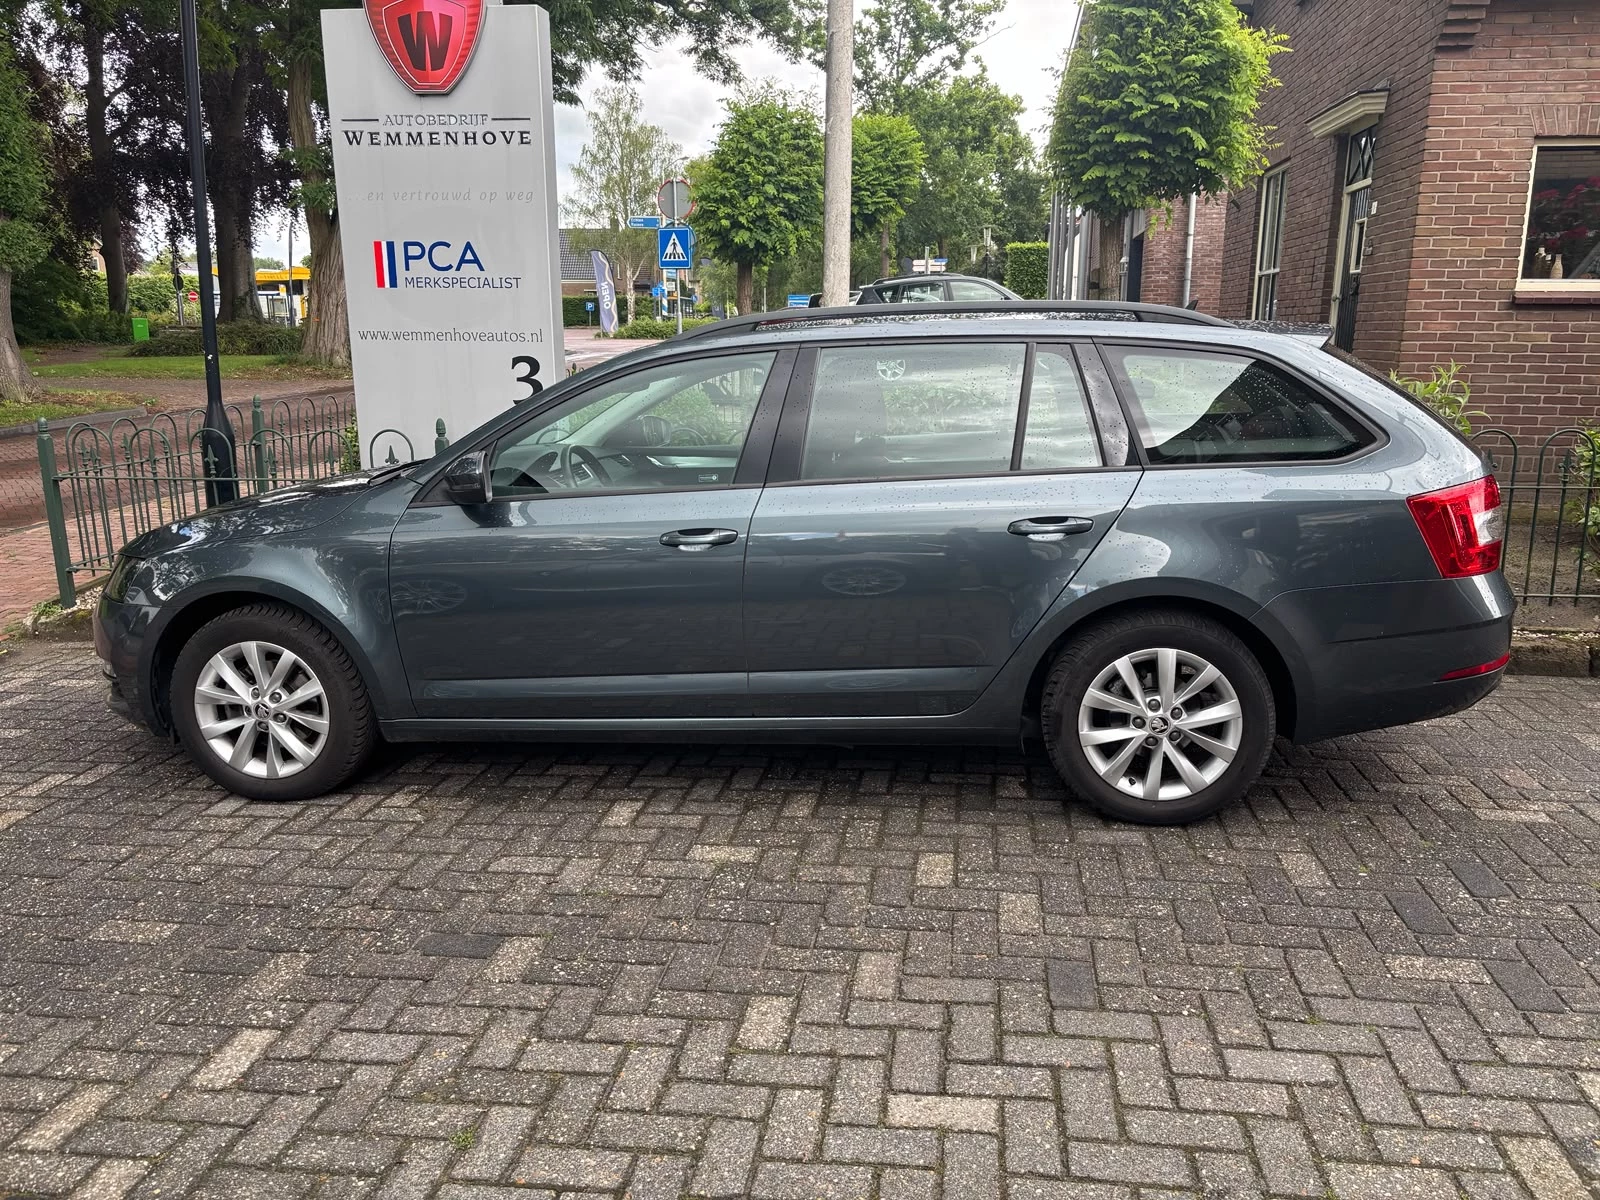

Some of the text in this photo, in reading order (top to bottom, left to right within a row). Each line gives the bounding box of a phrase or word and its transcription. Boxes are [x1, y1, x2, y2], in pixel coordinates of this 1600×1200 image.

[397, 11, 453, 71] W
[383, 114, 489, 126] AUTOBEDRIJF
[342, 130, 532, 146] WEMMENHOVE
[393, 187, 471, 201] vertrouwd
[479, 191, 497, 204] op
[505, 191, 534, 204] weg
[403, 241, 485, 272] PCA
[404, 277, 522, 289] MERKSPECIALIST
[358, 328, 543, 343] www.wemmenhoveautos.nl
[511, 355, 544, 404] 3
